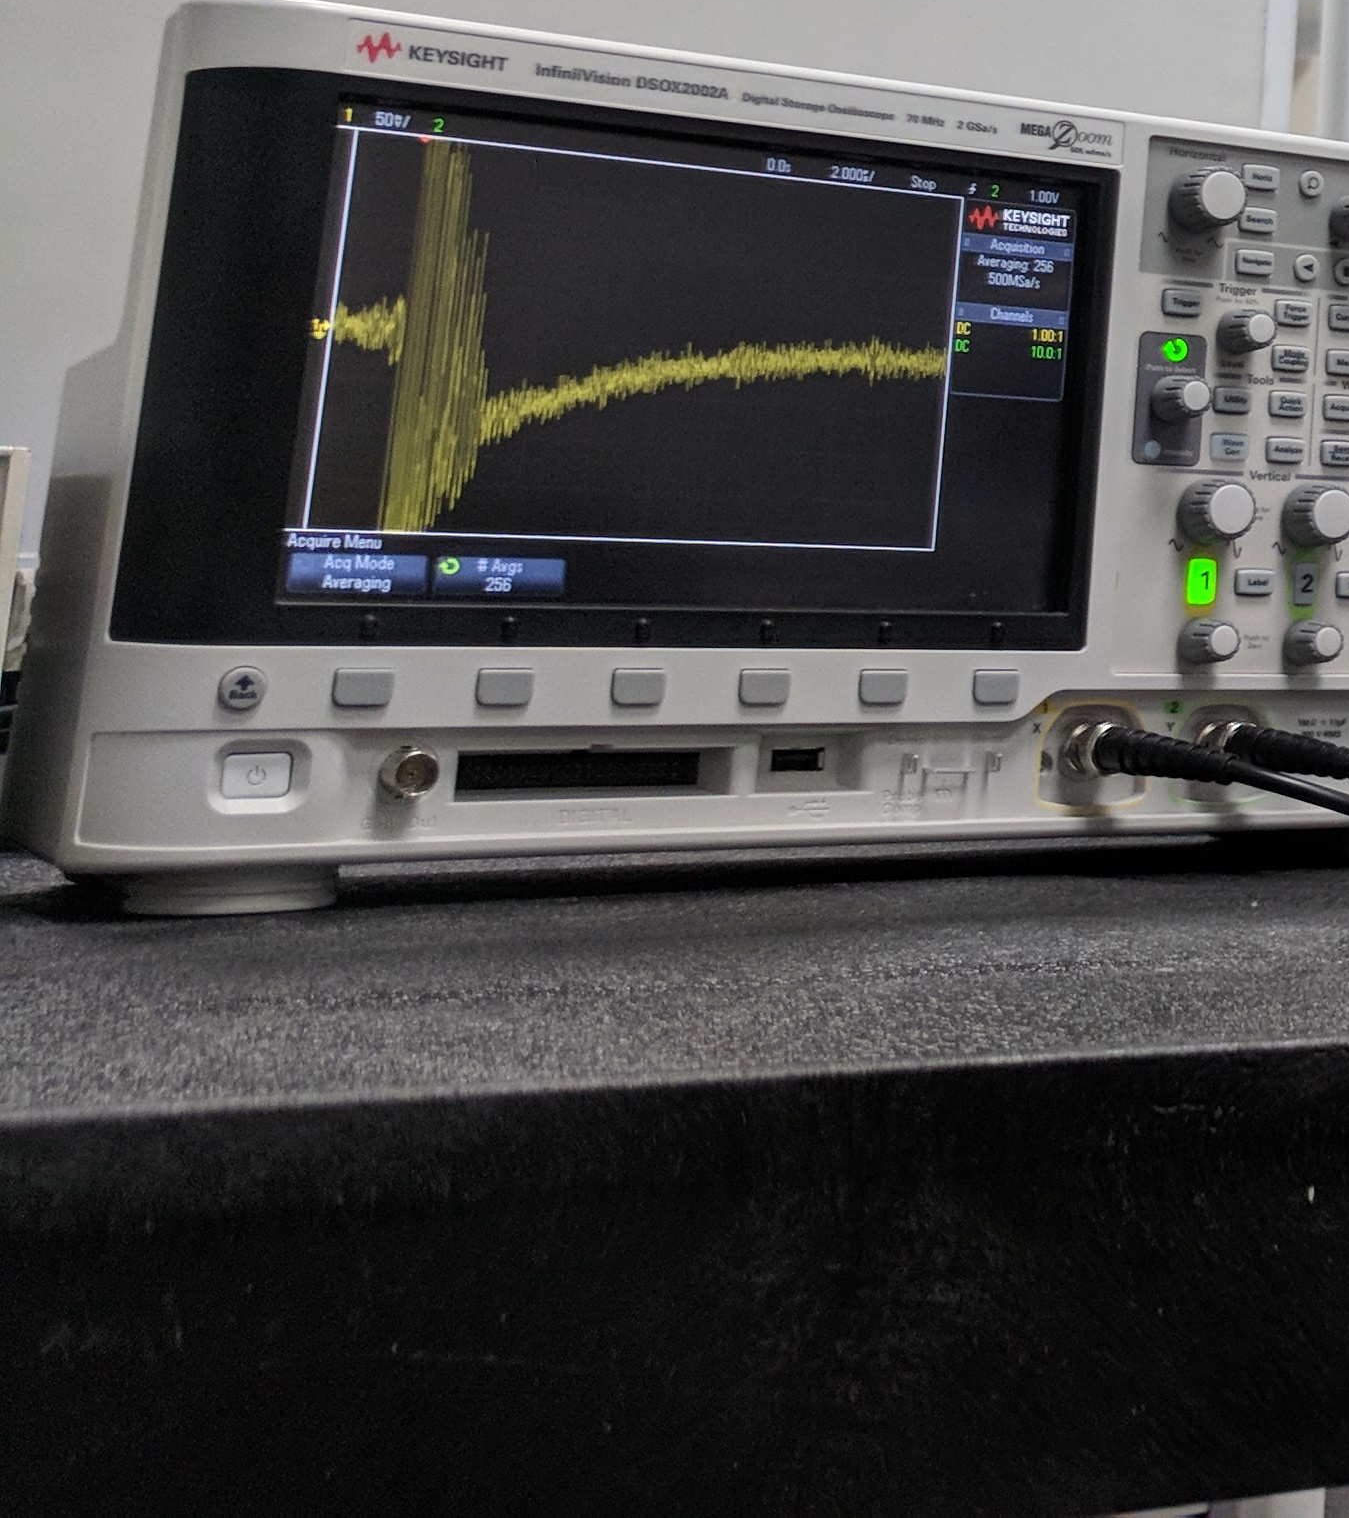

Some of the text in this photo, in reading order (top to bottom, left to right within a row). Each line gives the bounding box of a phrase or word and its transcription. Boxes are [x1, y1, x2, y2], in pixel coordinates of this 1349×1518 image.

[409, 45, 509, 72] KEYSIGHT
[635, 76, 729, 100] DSOX2002A
[742, 92, 780, 109] Digital
[781, 97, 826, 114] Storage
[828, 102, 895, 122] Oscilloscope
[957, 117, 965, 130] 2
[966, 119, 998, 135] GSa/s
[344, 107, 353, 122] 1
[432, 117, 445, 133] 2
[911, 175, 937, 192] Stop
[991, 185, 1000, 198] 2
[1029, 189, 1060, 204] 1.00V
[1003, 209, 1070, 228] KEYSIGHT
[1246, 214, 1274, 225] Search
[1003, 222, 1067, 237] TECHNOLOGIES
[990, 238, 1045, 255] Acquisition
[977, 254, 1054, 274] Averaging: 256
[988, 273, 1040, 289] 500MSa/s
[1219, 283, 1257, 296] Trigger
[1173, 297, 1200, 307] Trigger
[1286, 304, 1307, 312] Force
[990, 308, 1034, 323] Channels
[1283, 312, 1309, 321] Trigger
[956, 322, 971, 335] DC
[1032, 329, 1063, 342] 1.00:1
[955, 340, 970, 353] DC
[1031, 346, 1062, 360] 10.0:1
[1247, 375, 1274, 385] Tools
[1250, 471, 1291, 482] Vertical
[286, 532, 382, 550] Acquire Menu
[324, 554, 395, 572] Acq Mode
[491, 559, 524, 575] Avgs
[322, 574, 392, 592] Averaging
[484, 576, 512, 592] 256
[1200, 570, 1210, 590] 1
[1301, 573, 1314, 593] 2
[229, 690, 257, 700] Back
[1032, 723, 1041, 733] X
[1167, 722, 1176, 732] Y
